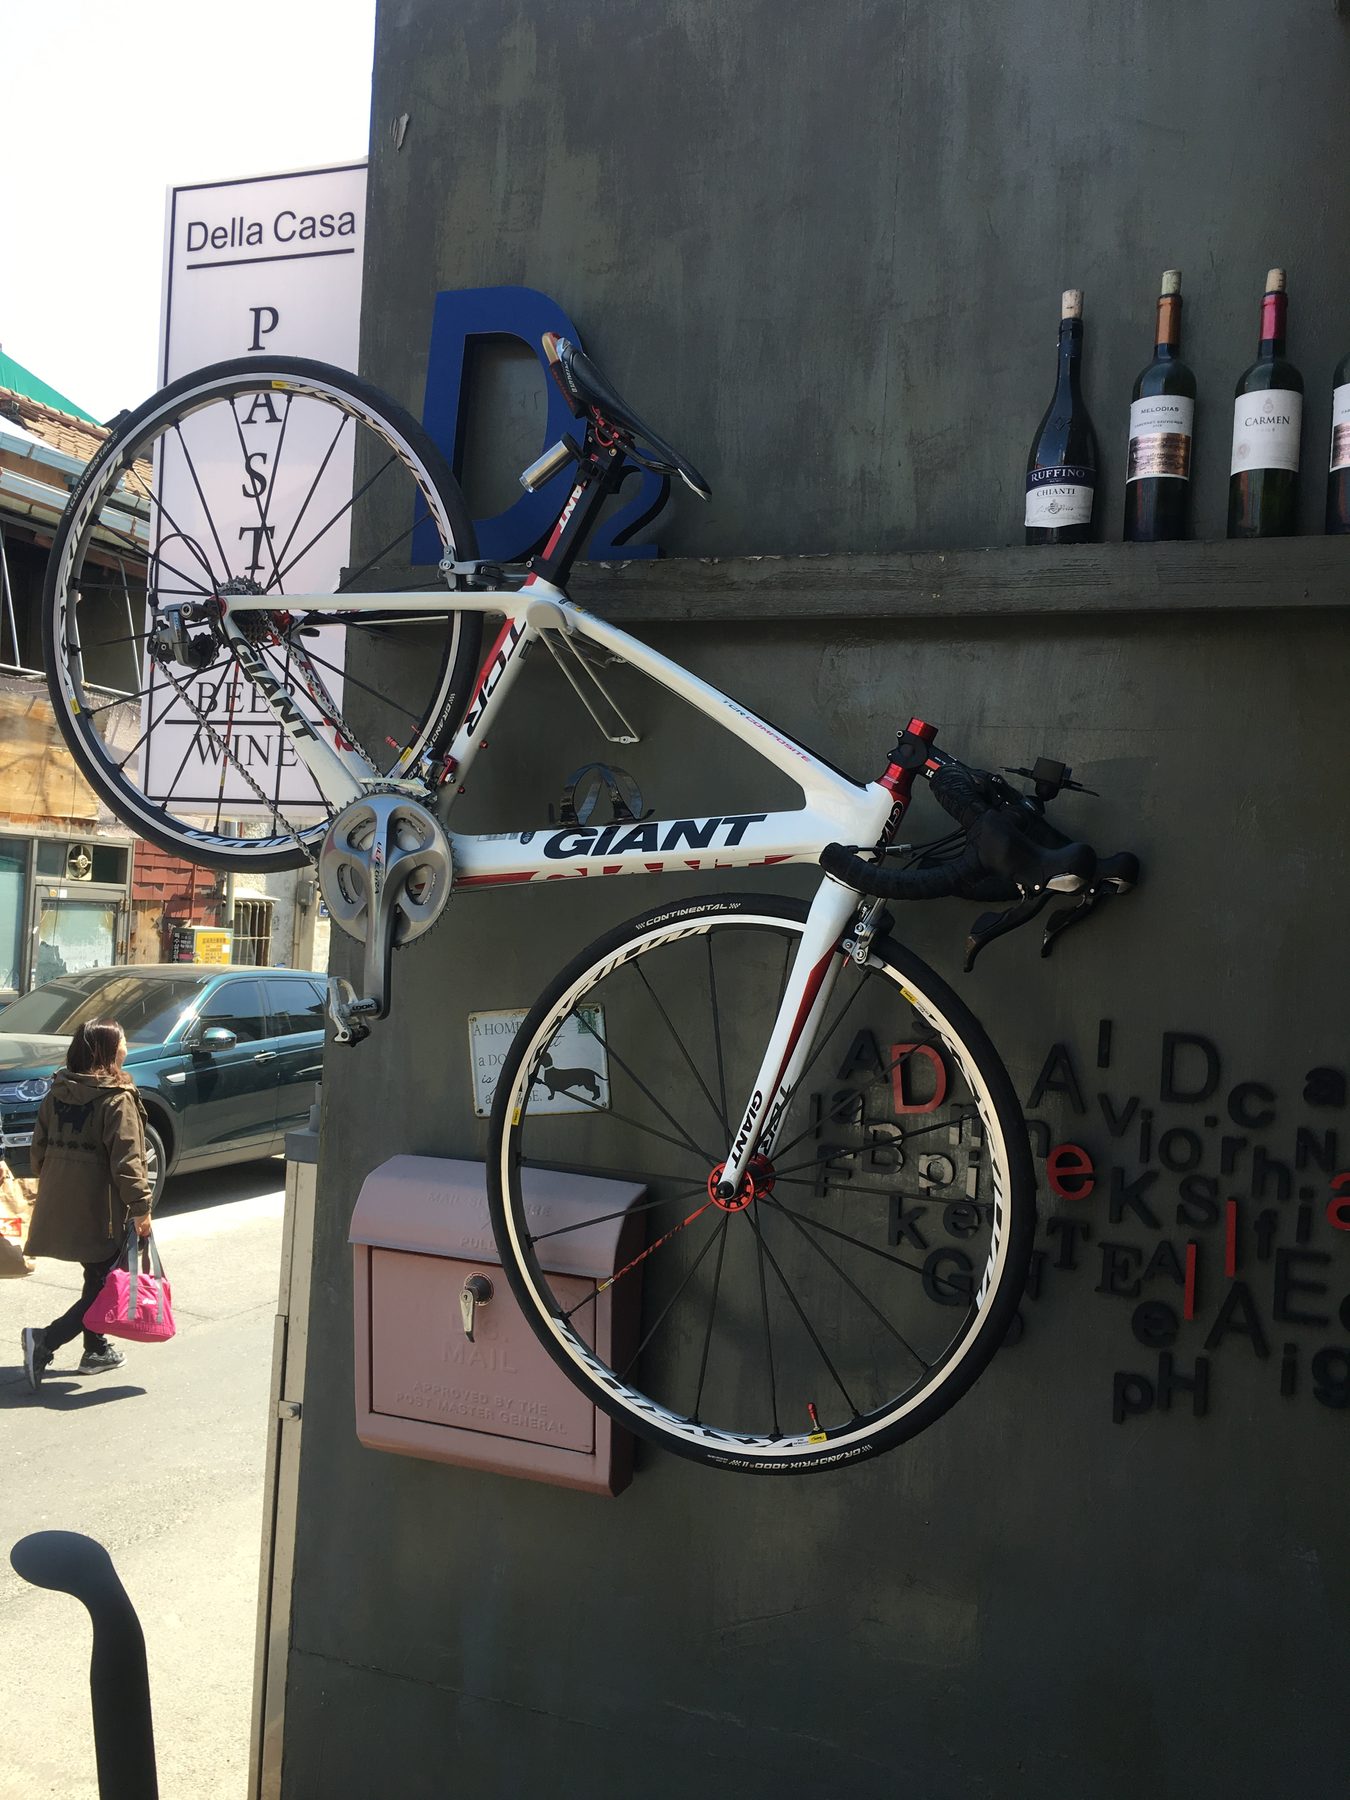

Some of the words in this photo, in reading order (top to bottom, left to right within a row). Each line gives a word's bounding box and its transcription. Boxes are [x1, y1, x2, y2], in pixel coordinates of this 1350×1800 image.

[186, 216, 263, 252] Della
[273, 210, 356, 243] Casa
[1140, 406, 1180, 414] MELODIAS
[1244, 416, 1290, 427] CARMEN
[1031, 468, 1086, 482] RUFFINO
[1036, 488, 1076, 497] CHIANTI
[230, 637, 319, 741] GIANT
[464, 622, 526, 737] TCR
[196, 682, 296, 714] BEE
[193, 734, 299, 767] WINE
[745, 716, 812, 762] COMPOSITE
[544, 814, 768, 860] GIANT
[646, 903, 727, 927] CONTINENTAL
[473, 1024, 482, 1036] A
[478, 1056, 486, 1067] a
[488, 1053, 506, 1066] DO
[731, 1090, 763, 1169] GIANT
[441, 1341, 519, 1376] MAIL
[395, 1391, 432, 1408] POST
[436, 1398, 495, 1420] MASTER
[500, 1411, 568, 1436] GENERAL
[412, 1381, 489, 1404] APPROVED
[494, 1394, 514, 1409] BY
[519, 1400, 549, 1417] THE
